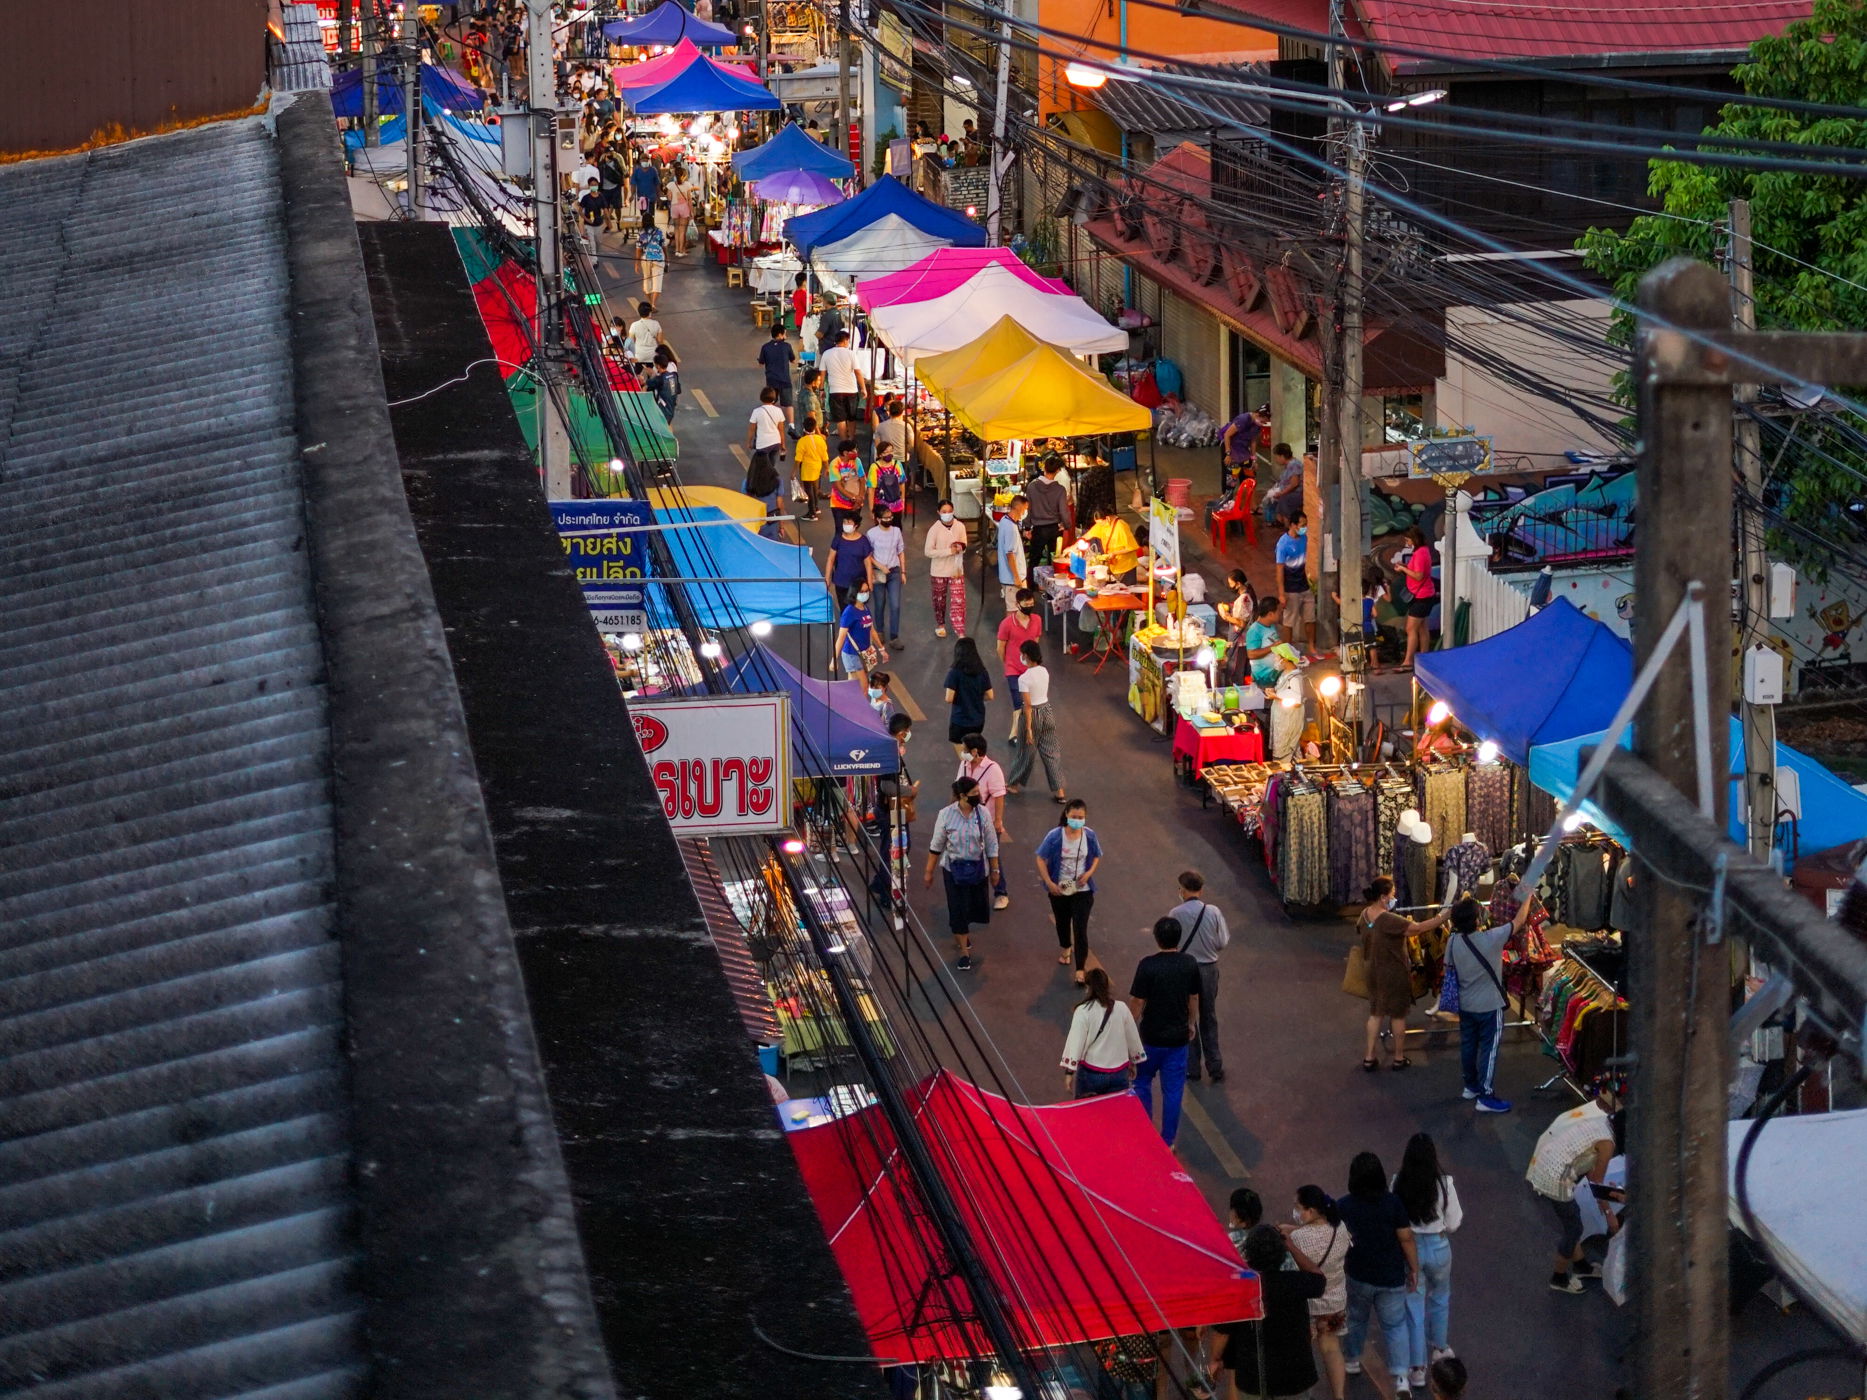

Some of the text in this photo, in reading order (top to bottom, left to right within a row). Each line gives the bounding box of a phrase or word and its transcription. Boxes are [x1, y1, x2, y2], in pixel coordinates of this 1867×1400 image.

[558, 511, 641, 525] ประเทศไทย จำกัด
[833, 762, 881, 771] LUCKYFRIEND
